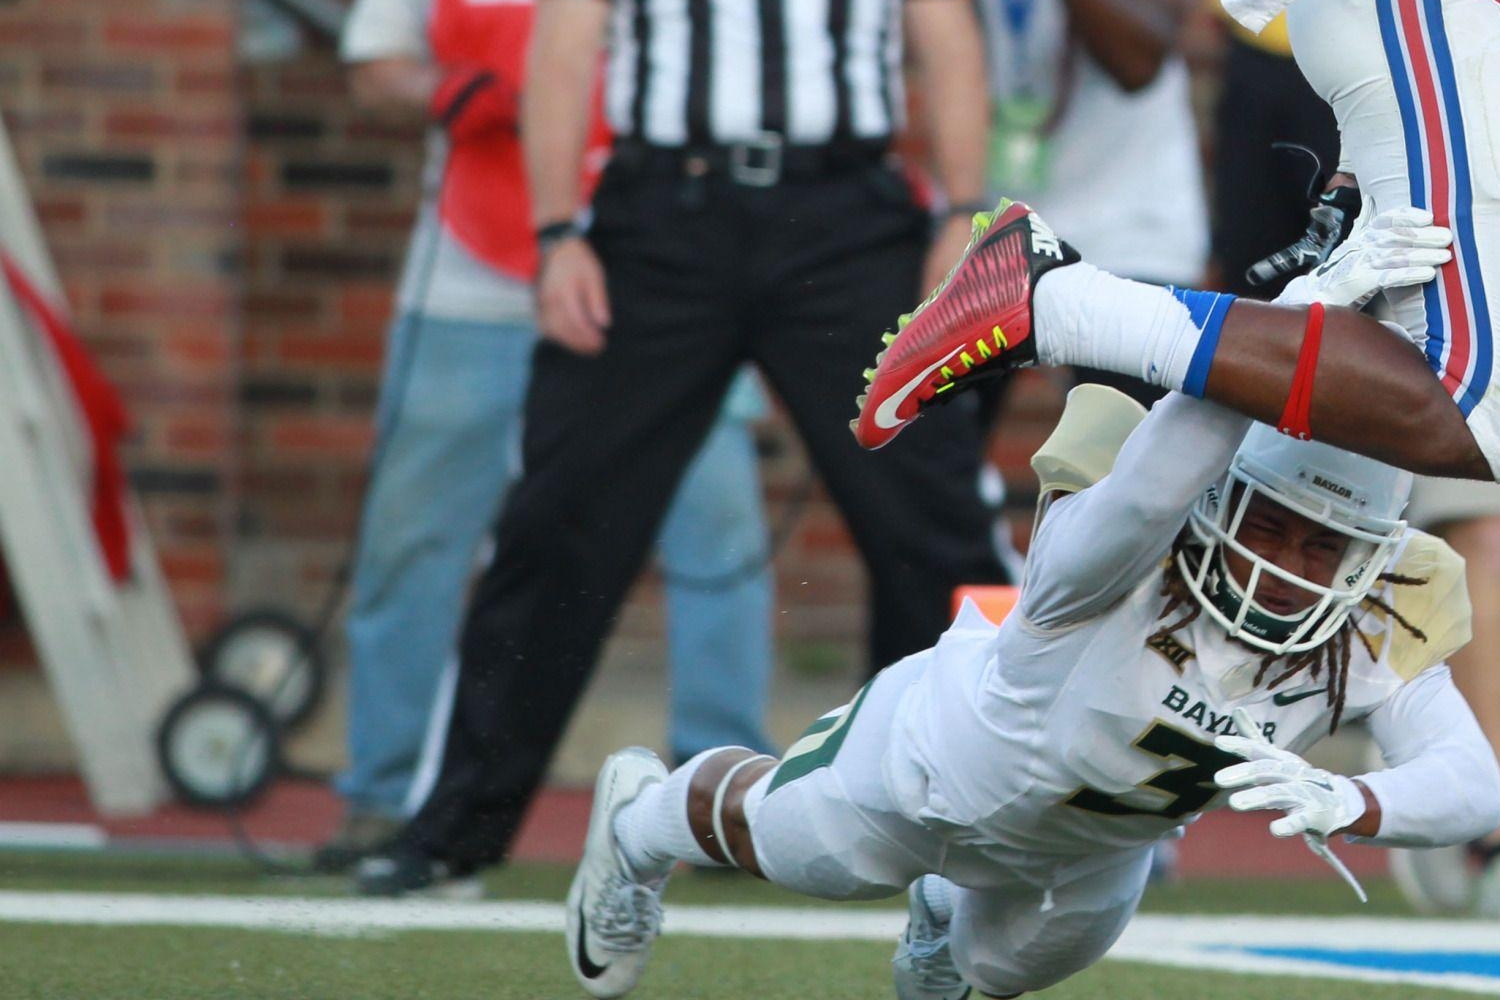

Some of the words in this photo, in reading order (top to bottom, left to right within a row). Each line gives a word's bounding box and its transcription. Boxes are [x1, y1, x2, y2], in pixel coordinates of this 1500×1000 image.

[1311, 474, 1353, 500] BAYLOR
[1161, 684, 1277, 745] BAYLR
[1056, 716, 1250, 821] 3
